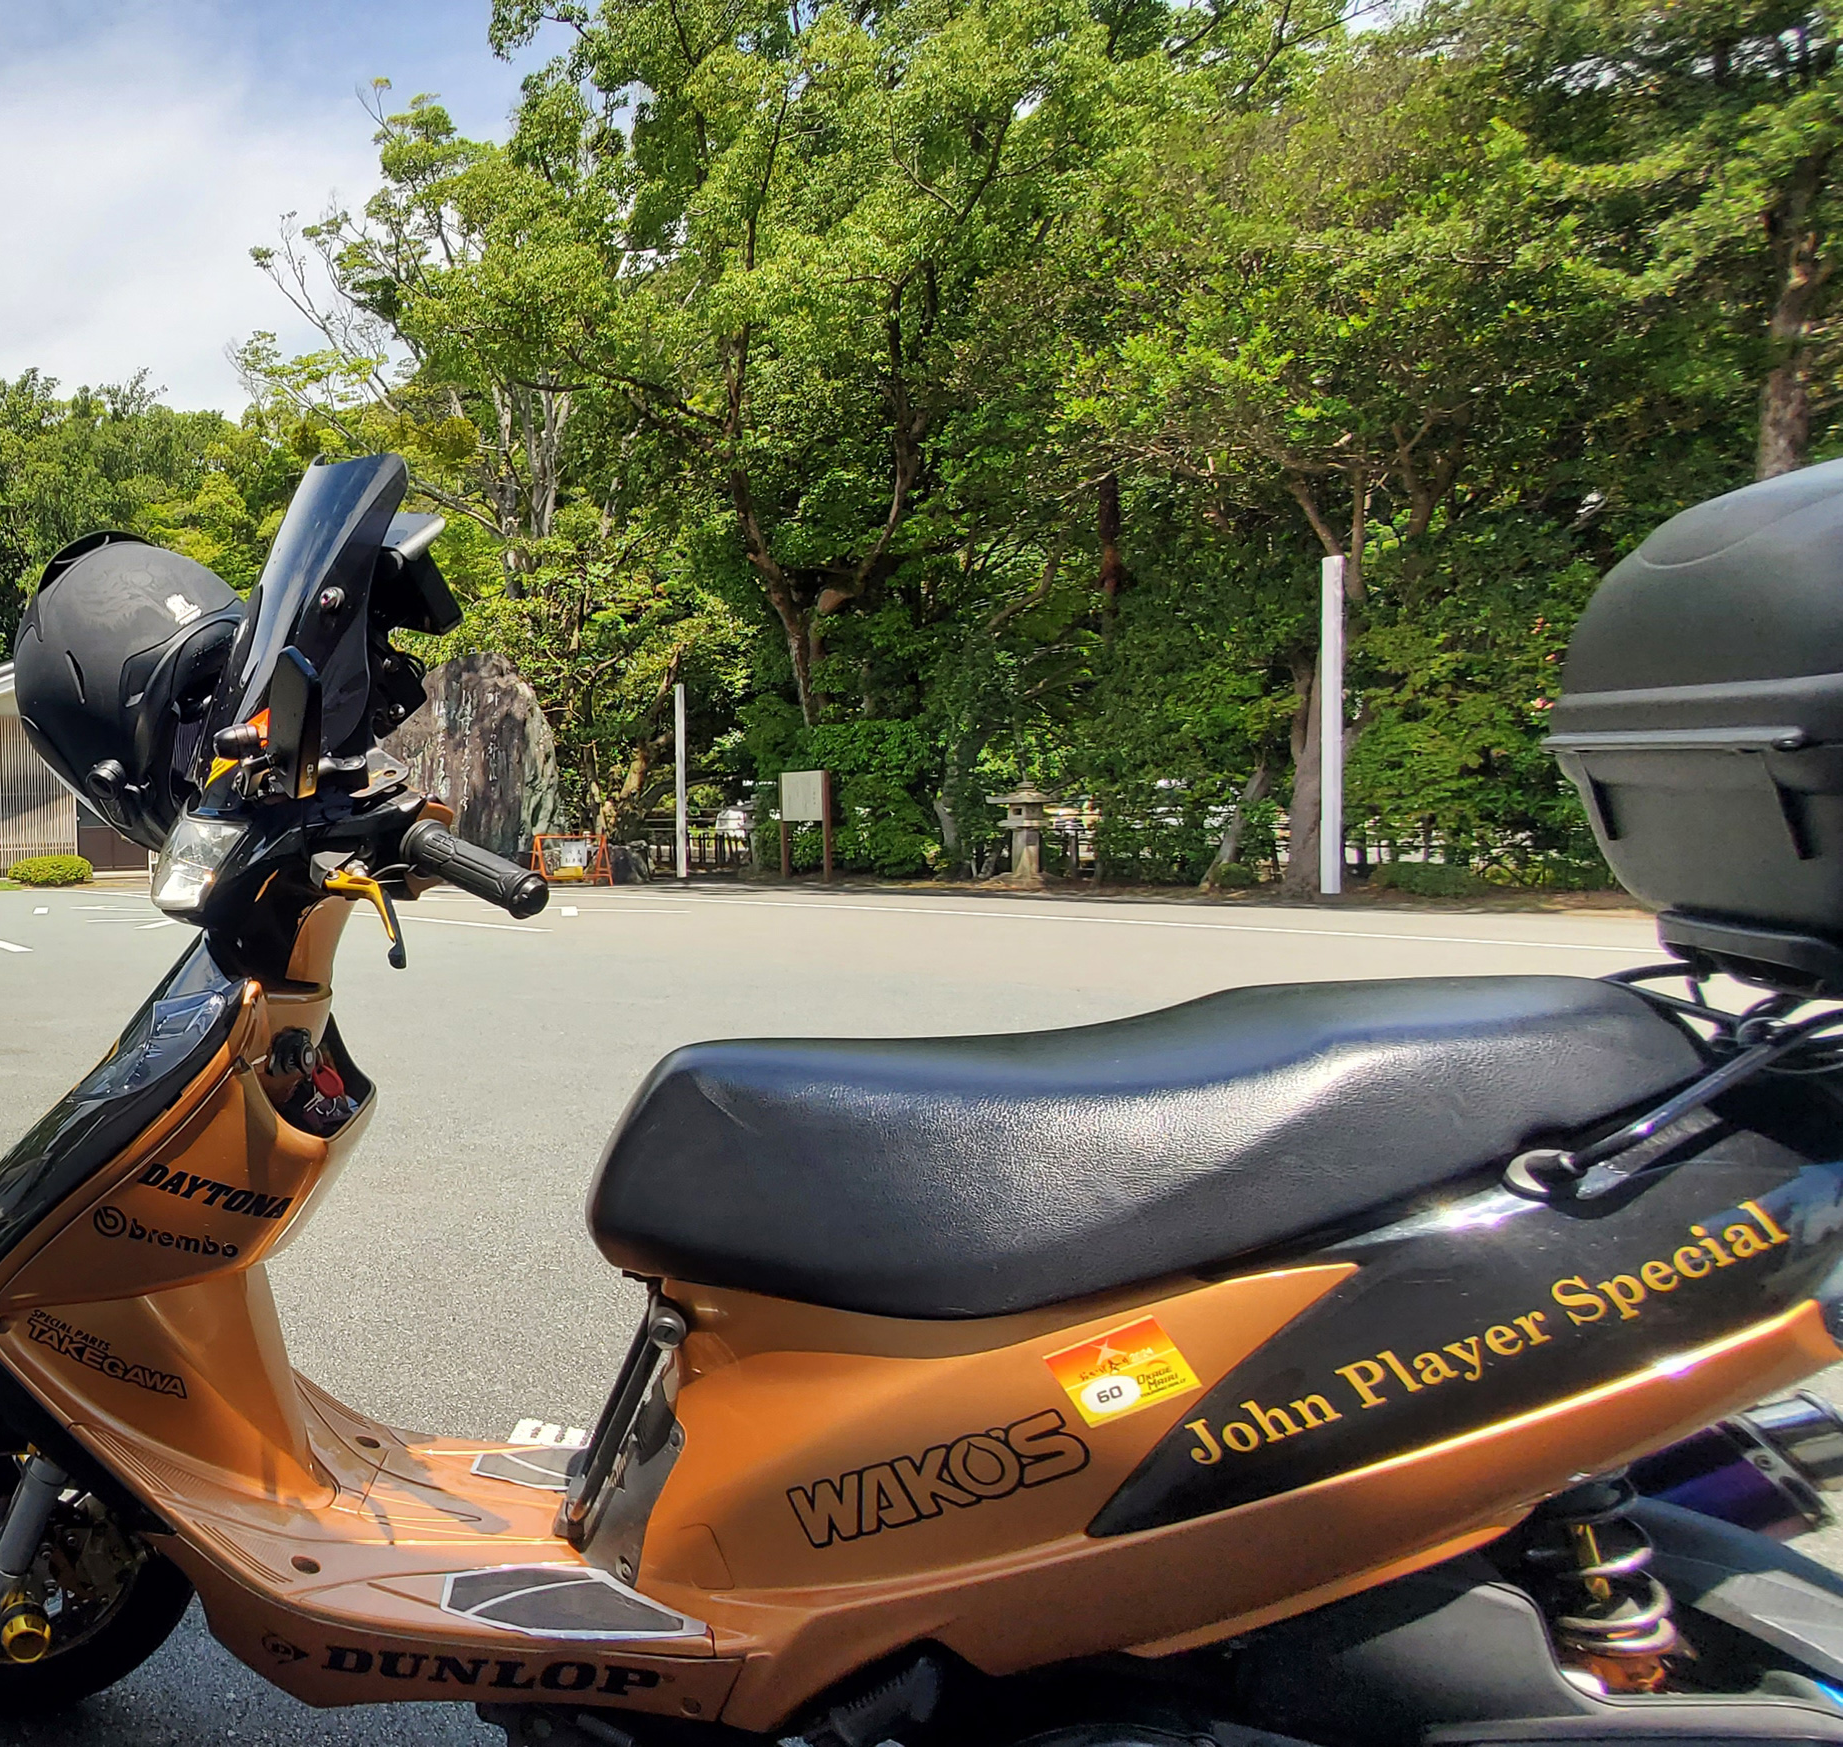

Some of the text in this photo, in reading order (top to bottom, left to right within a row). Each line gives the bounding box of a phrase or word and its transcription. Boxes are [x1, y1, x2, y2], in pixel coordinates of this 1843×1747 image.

[137, 1163, 295, 1220] DAYTONA
[128, 1218, 239, 1258] brembo
[30, 1309, 111, 1352] SPECIAL PARTS
[1184, 1200, 1790, 1466] John Player Special
[27, 1317, 188, 1399] TAKEGAWA
[1096, 1385, 1123, 1404] 60
[321, 1645, 661, 1696] DUNLOP
